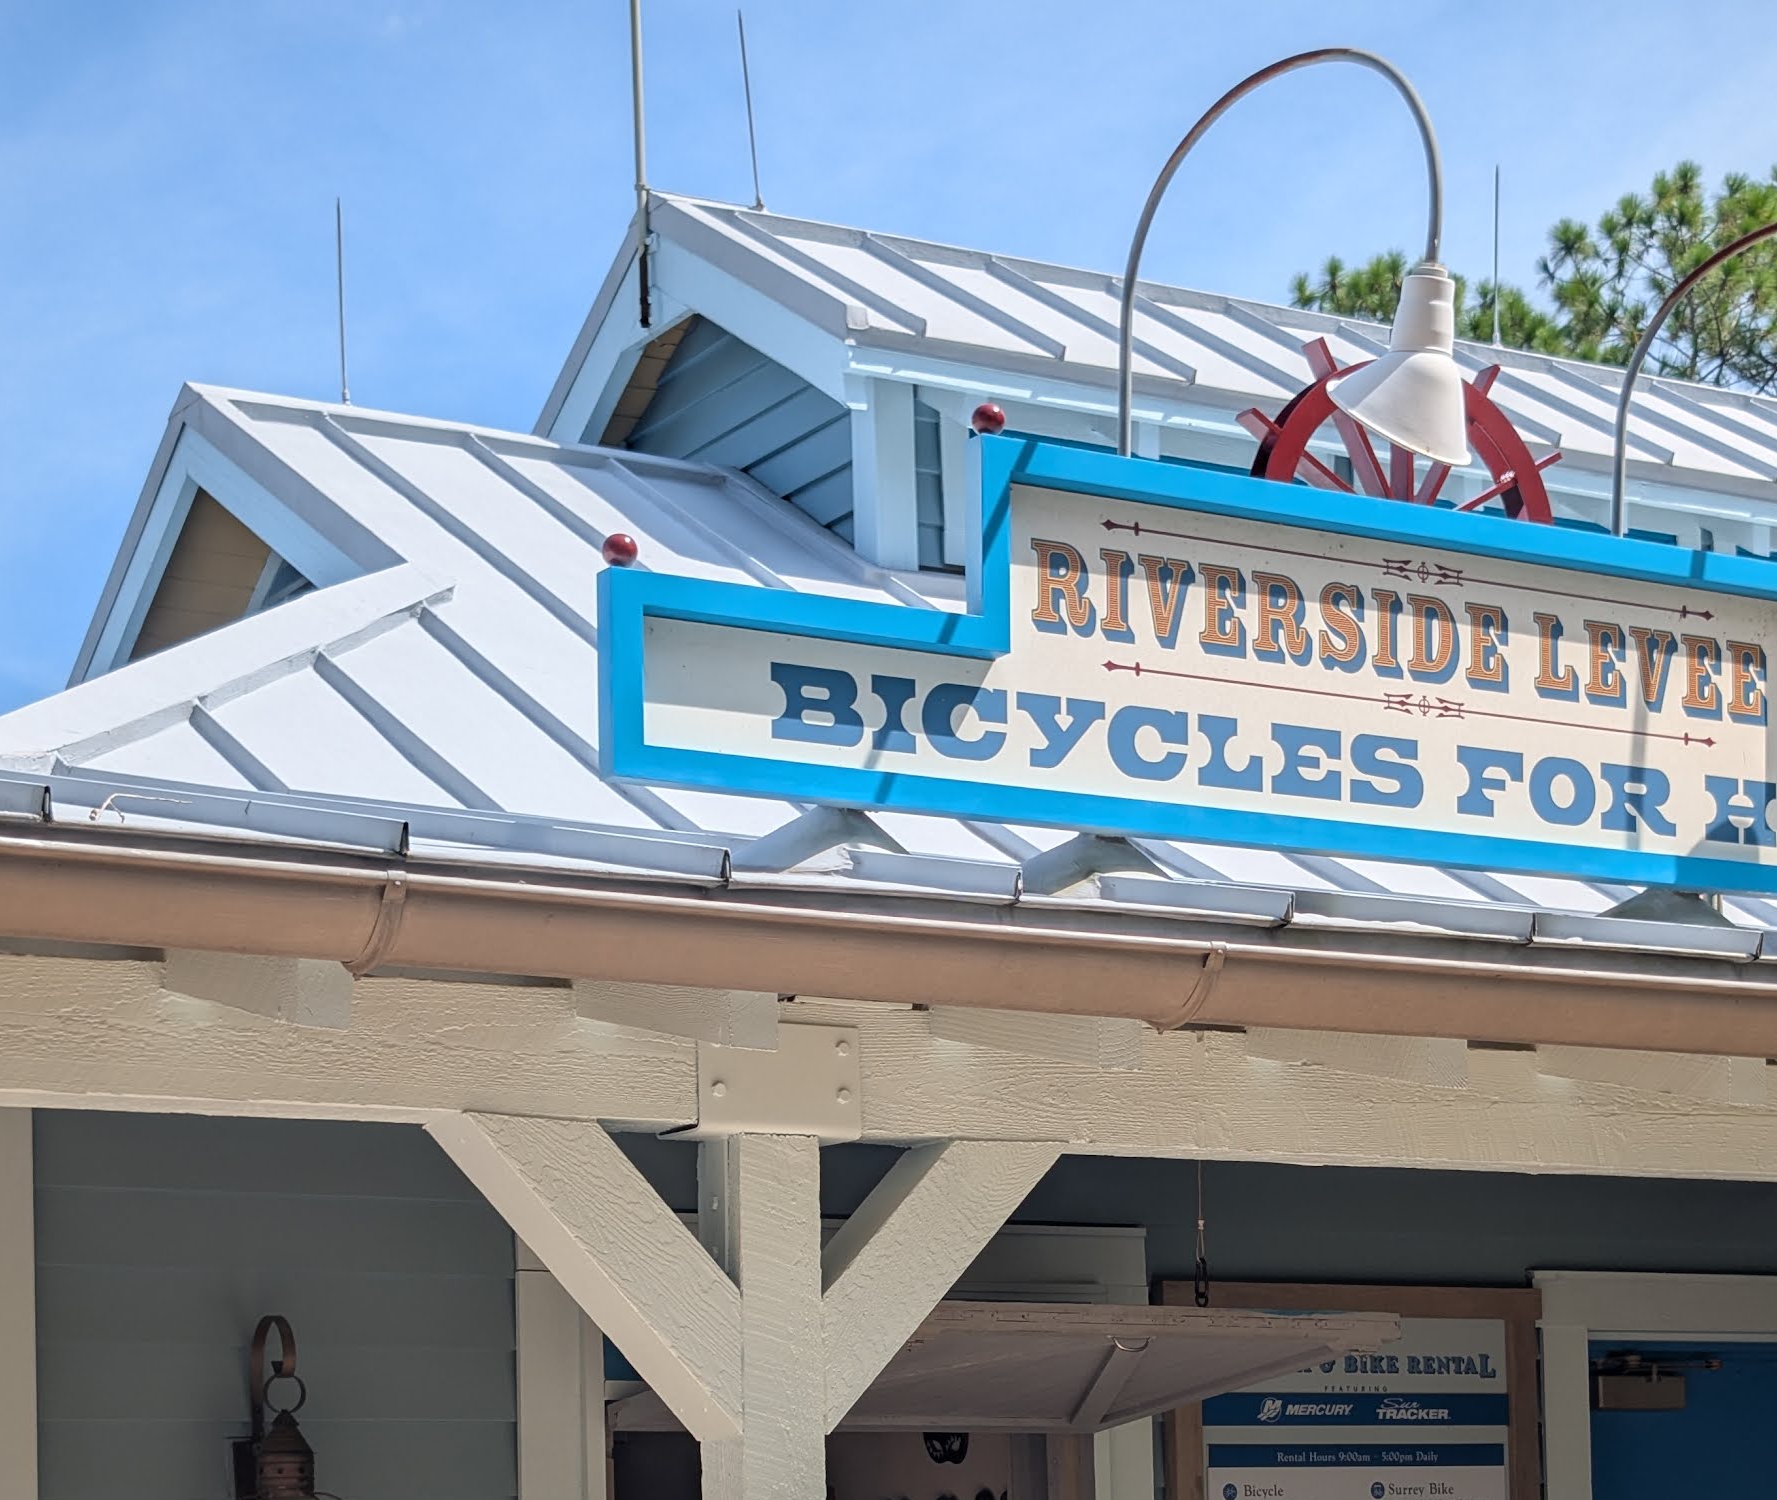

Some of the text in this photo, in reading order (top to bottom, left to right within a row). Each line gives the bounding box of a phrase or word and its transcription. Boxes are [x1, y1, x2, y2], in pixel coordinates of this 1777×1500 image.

[1030, 538, 1767, 727] RIVERSIDE LEVEE
[771, 661, 1423, 809] BICYCLES
[1456, 745, 1676, 837] FOR
[1407, 1353, 1496, 1378] RENTAL
[1324, 1385, 1388, 1393] FEATURING
[1285, 1404, 1353, 1416] MERCURY
[1376, 1409, 1449, 1420] TRACKER
[1277, 1452, 1305, 1462] Rental
[1309, 1452, 1336, 1462] Hours
[1338, 1451, 1370, 1462] 9:00am
[1382, 1451, 1413, 1463] 5:00pm
[1416, 1451, 1438, 1462] Daily
[1244, 1484, 1283, 1498] Bicycle
[1388, 1483, 1454, 1497] Surrey Bike
